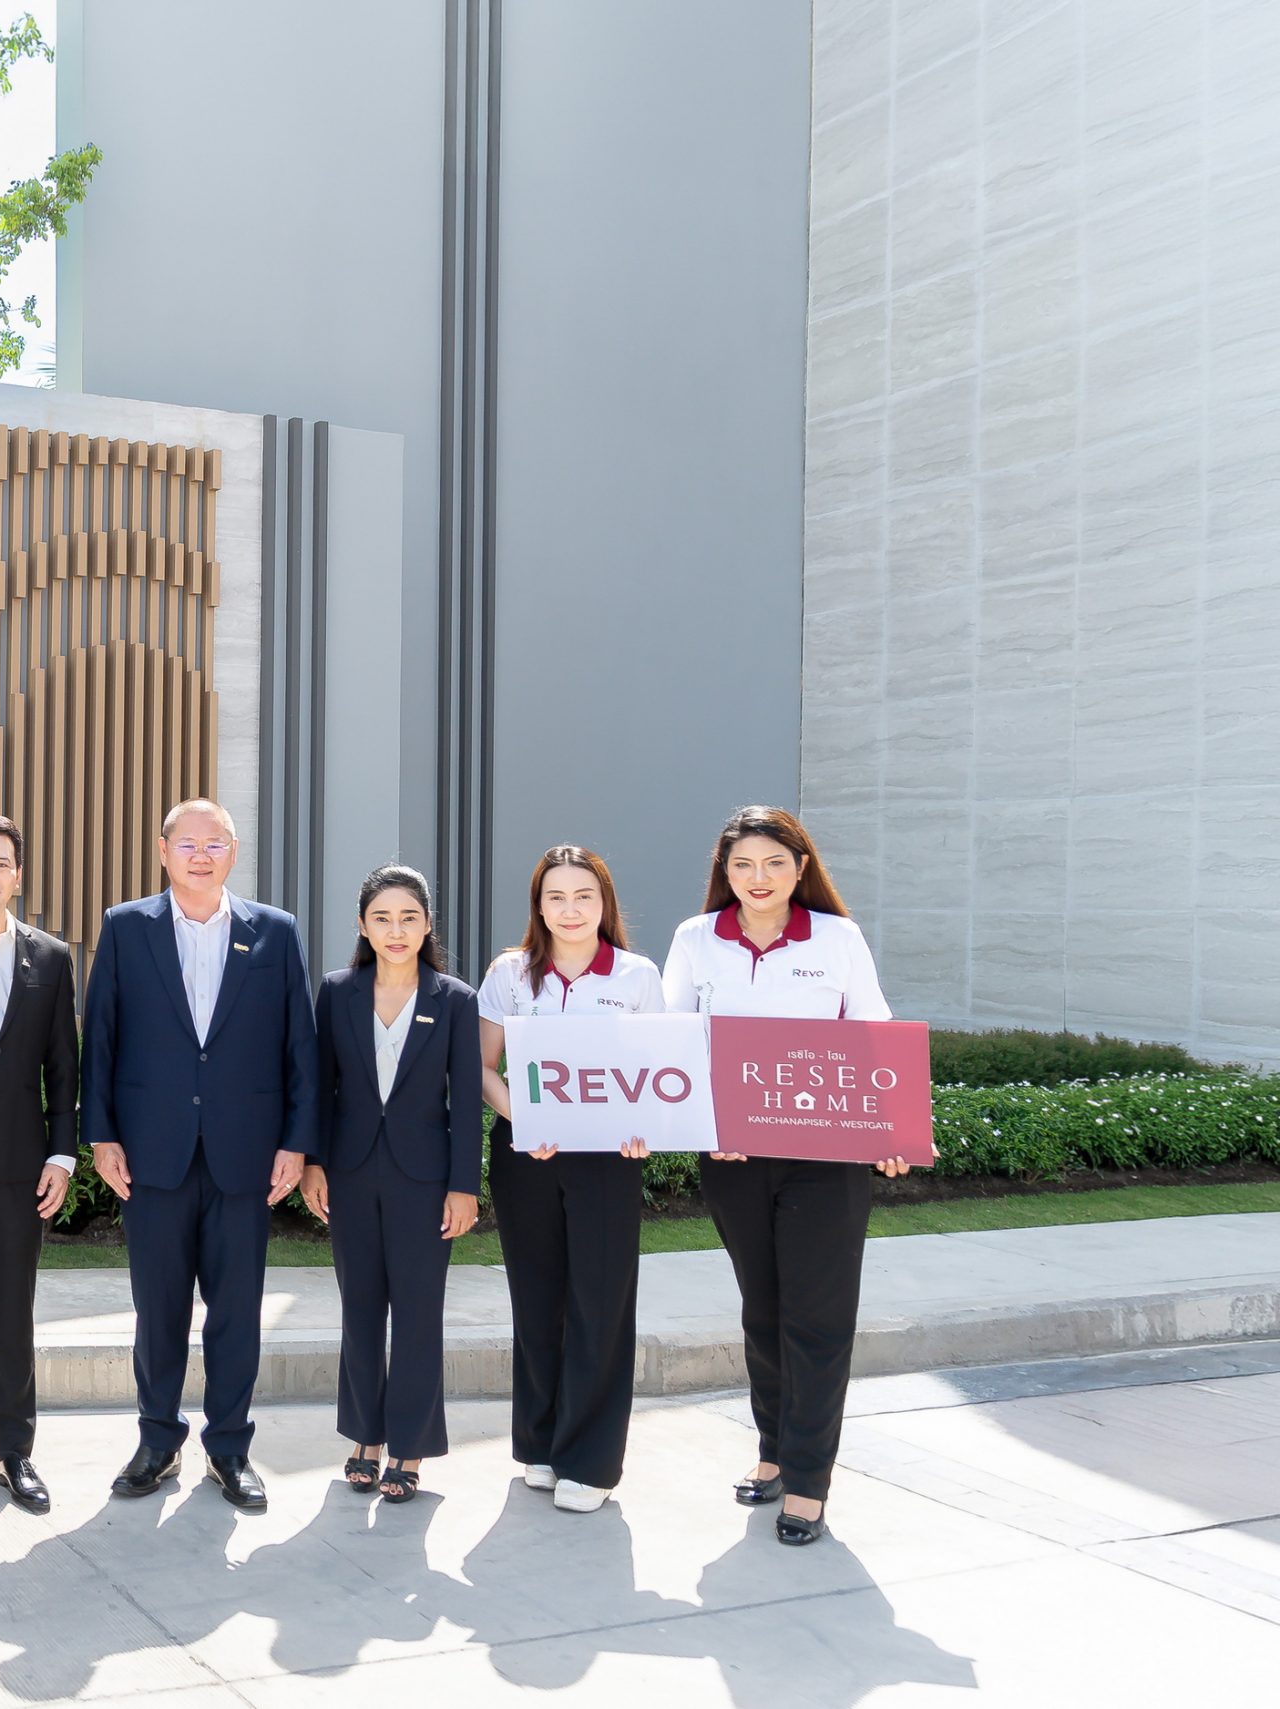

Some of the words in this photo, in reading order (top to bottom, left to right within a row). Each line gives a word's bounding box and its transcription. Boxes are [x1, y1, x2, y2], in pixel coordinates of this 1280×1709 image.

[792, 968, 825, 978] REVO
[597, 998, 625, 1009] REVO
[527, 1060, 692, 1104] REVO
[741, 1062, 898, 1090] RESEO
[748, 1115, 832, 1128] KANCHANAPISEK
[840, 1120, 894, 1131] WESTGATE
